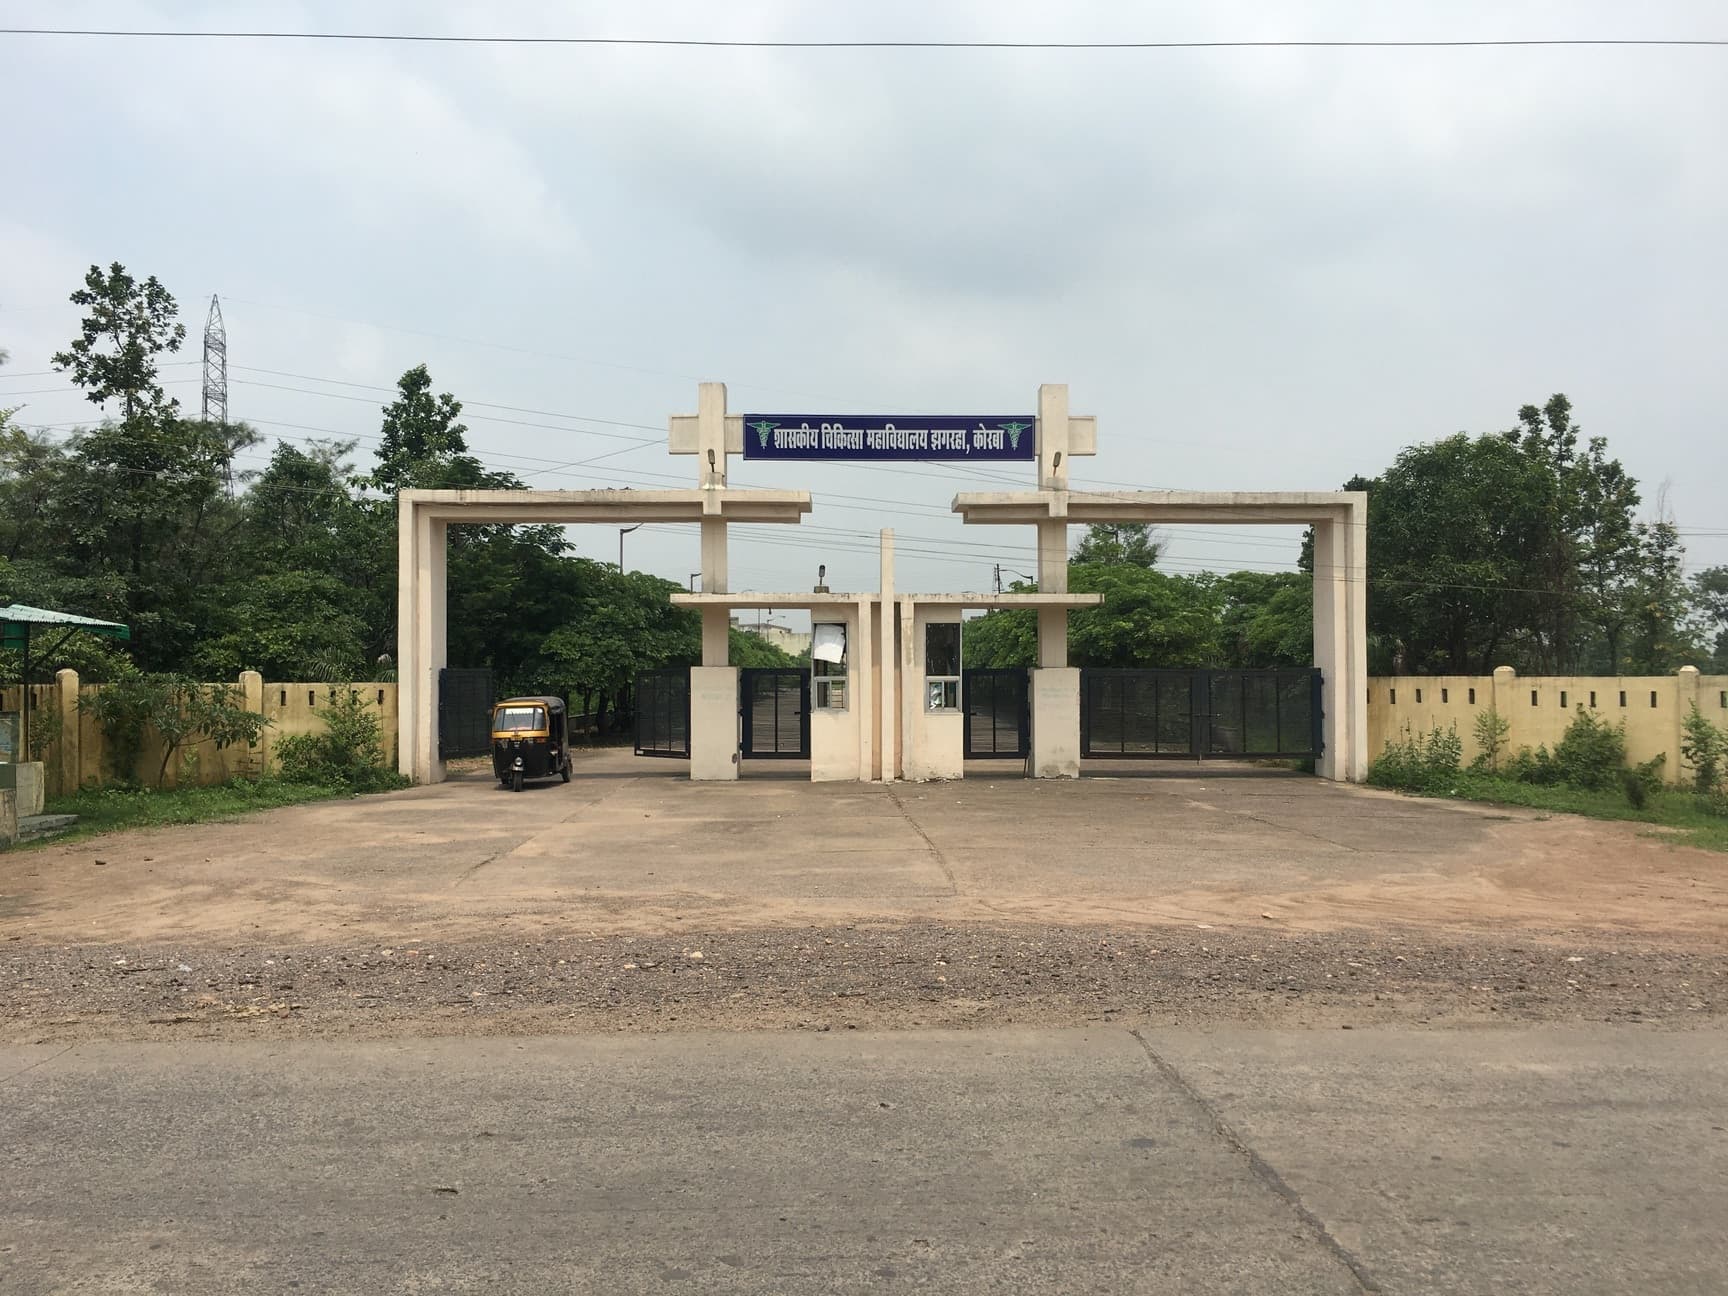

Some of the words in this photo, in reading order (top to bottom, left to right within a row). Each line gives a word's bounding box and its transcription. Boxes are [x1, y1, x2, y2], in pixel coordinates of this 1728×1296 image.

[774, 422, 818, 449] शासकीय
[821, 423, 863, 449] चिकित्सा
[866, 424, 928, 449] महाविद्यालय
[973, 423, 1004, 449] कोरबा
